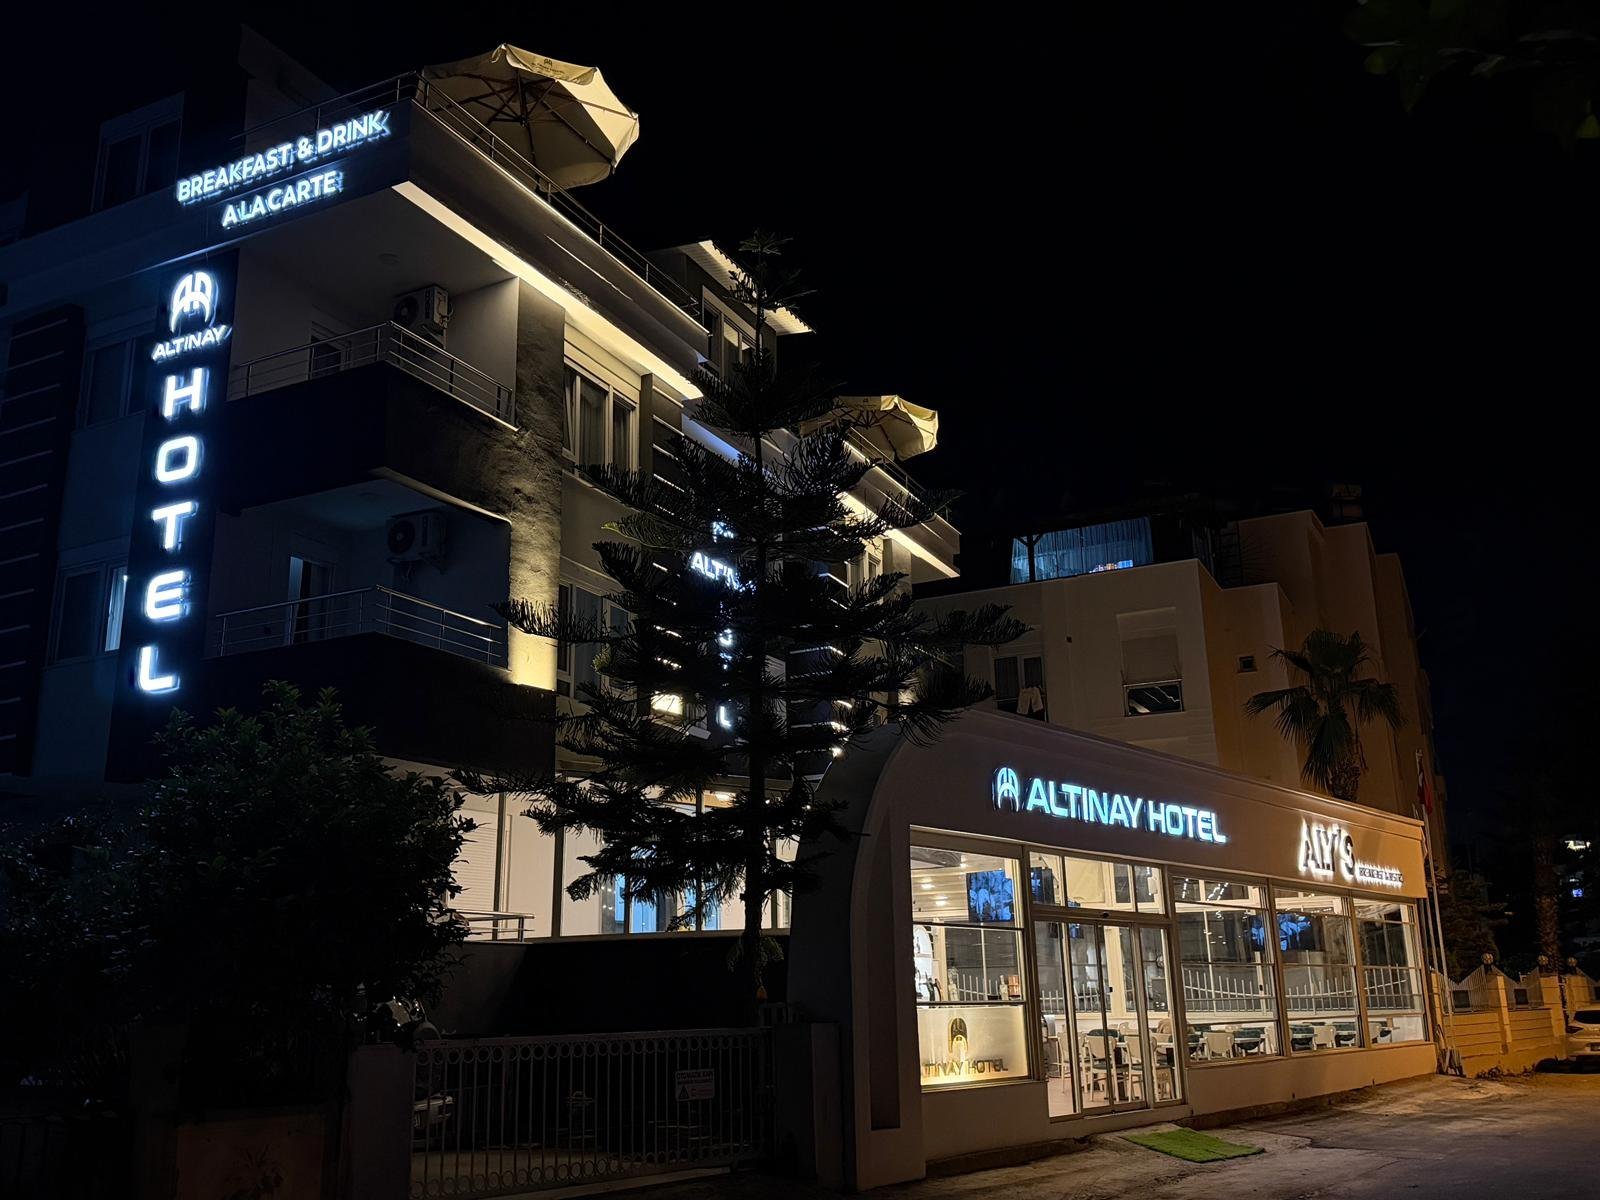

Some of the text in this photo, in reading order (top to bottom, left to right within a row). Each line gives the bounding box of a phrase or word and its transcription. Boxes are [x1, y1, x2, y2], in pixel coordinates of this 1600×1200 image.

[177, 110, 385, 203] BREAKFAST & DRINK
[151, 324, 227, 362] ALTINAY
[139, 367, 206, 692] HOTEL
[1025, 777, 1227, 844] ALTINAY HOTEL
